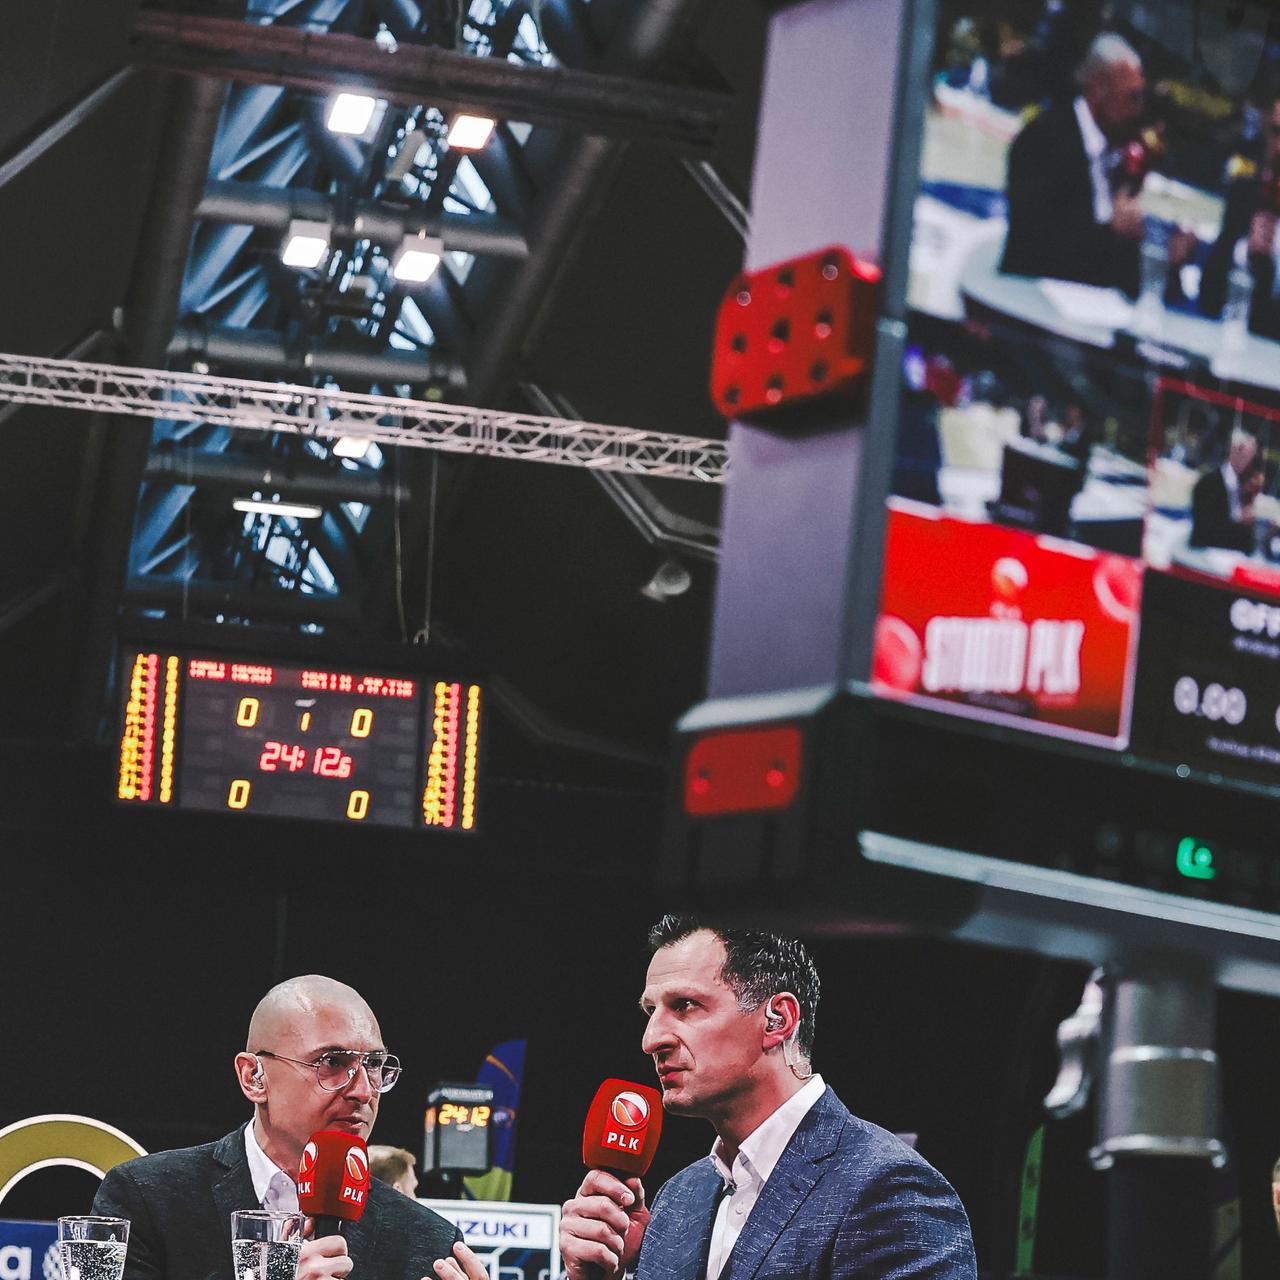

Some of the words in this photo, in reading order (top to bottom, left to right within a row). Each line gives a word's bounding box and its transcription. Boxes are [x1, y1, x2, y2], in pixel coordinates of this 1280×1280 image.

[236, 697, 260, 728] 0
[350, 707, 373, 738] 0
[228, 779, 251, 809] 0
[346, 790, 370, 820] 0
[607, 1131, 640, 1151] PLK
[343, 1186, 364, 1203] PLK
